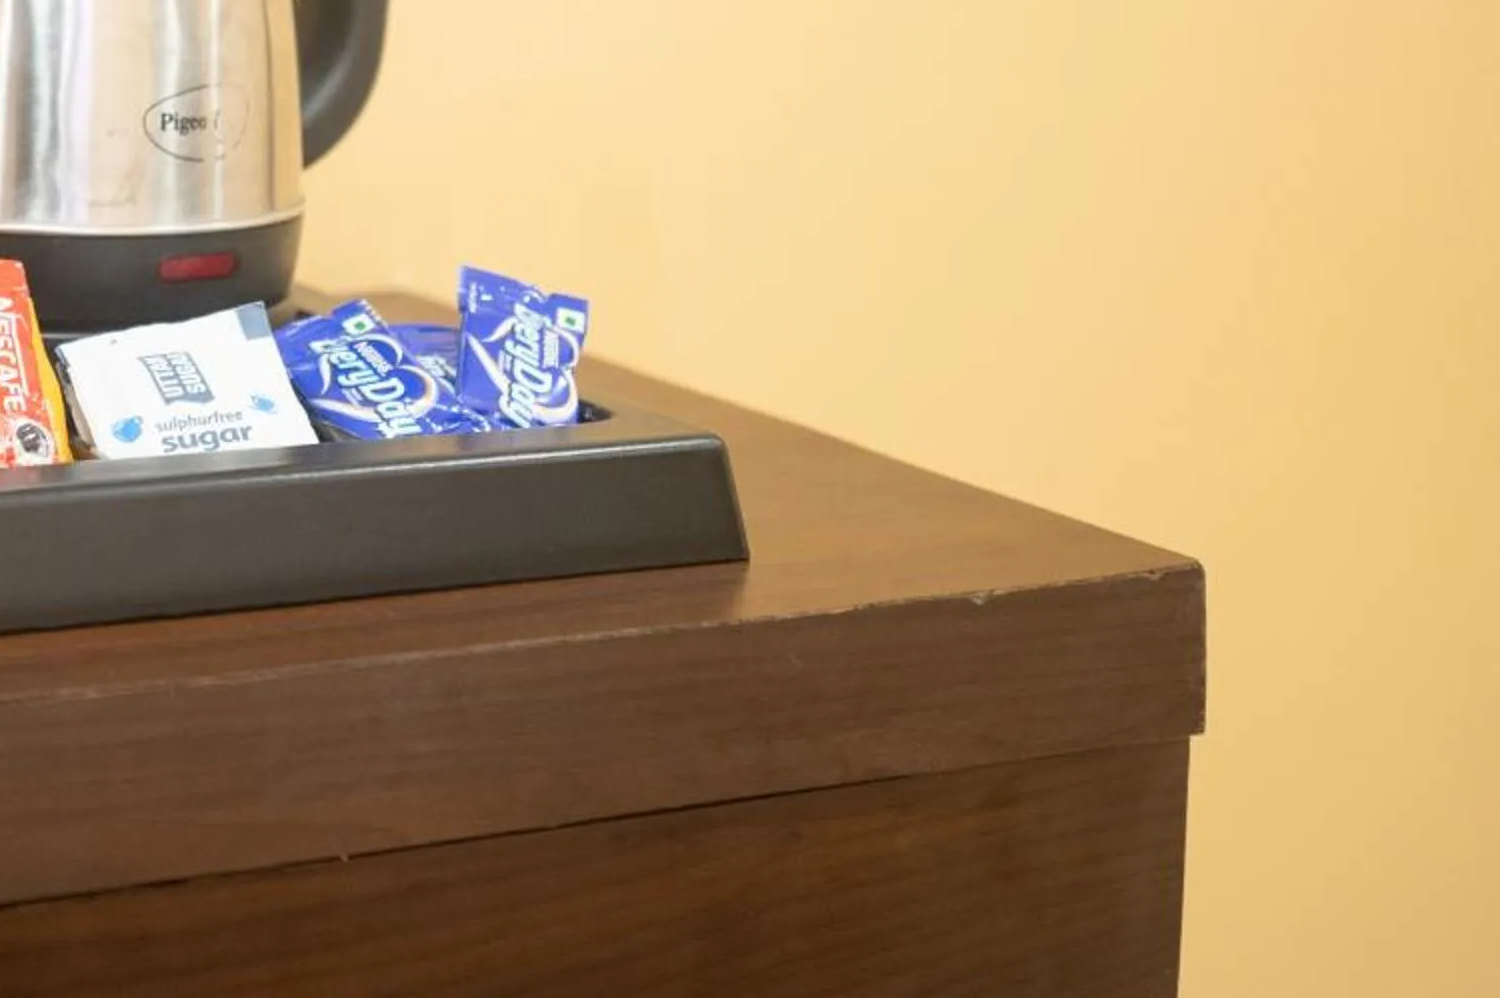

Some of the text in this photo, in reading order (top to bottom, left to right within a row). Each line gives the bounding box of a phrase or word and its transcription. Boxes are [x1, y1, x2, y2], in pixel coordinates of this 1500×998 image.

[161, 112, 208, 136] Pigeo
[154, 410, 243, 434] sulphurfree
[161, 424, 252, 453] sugar
